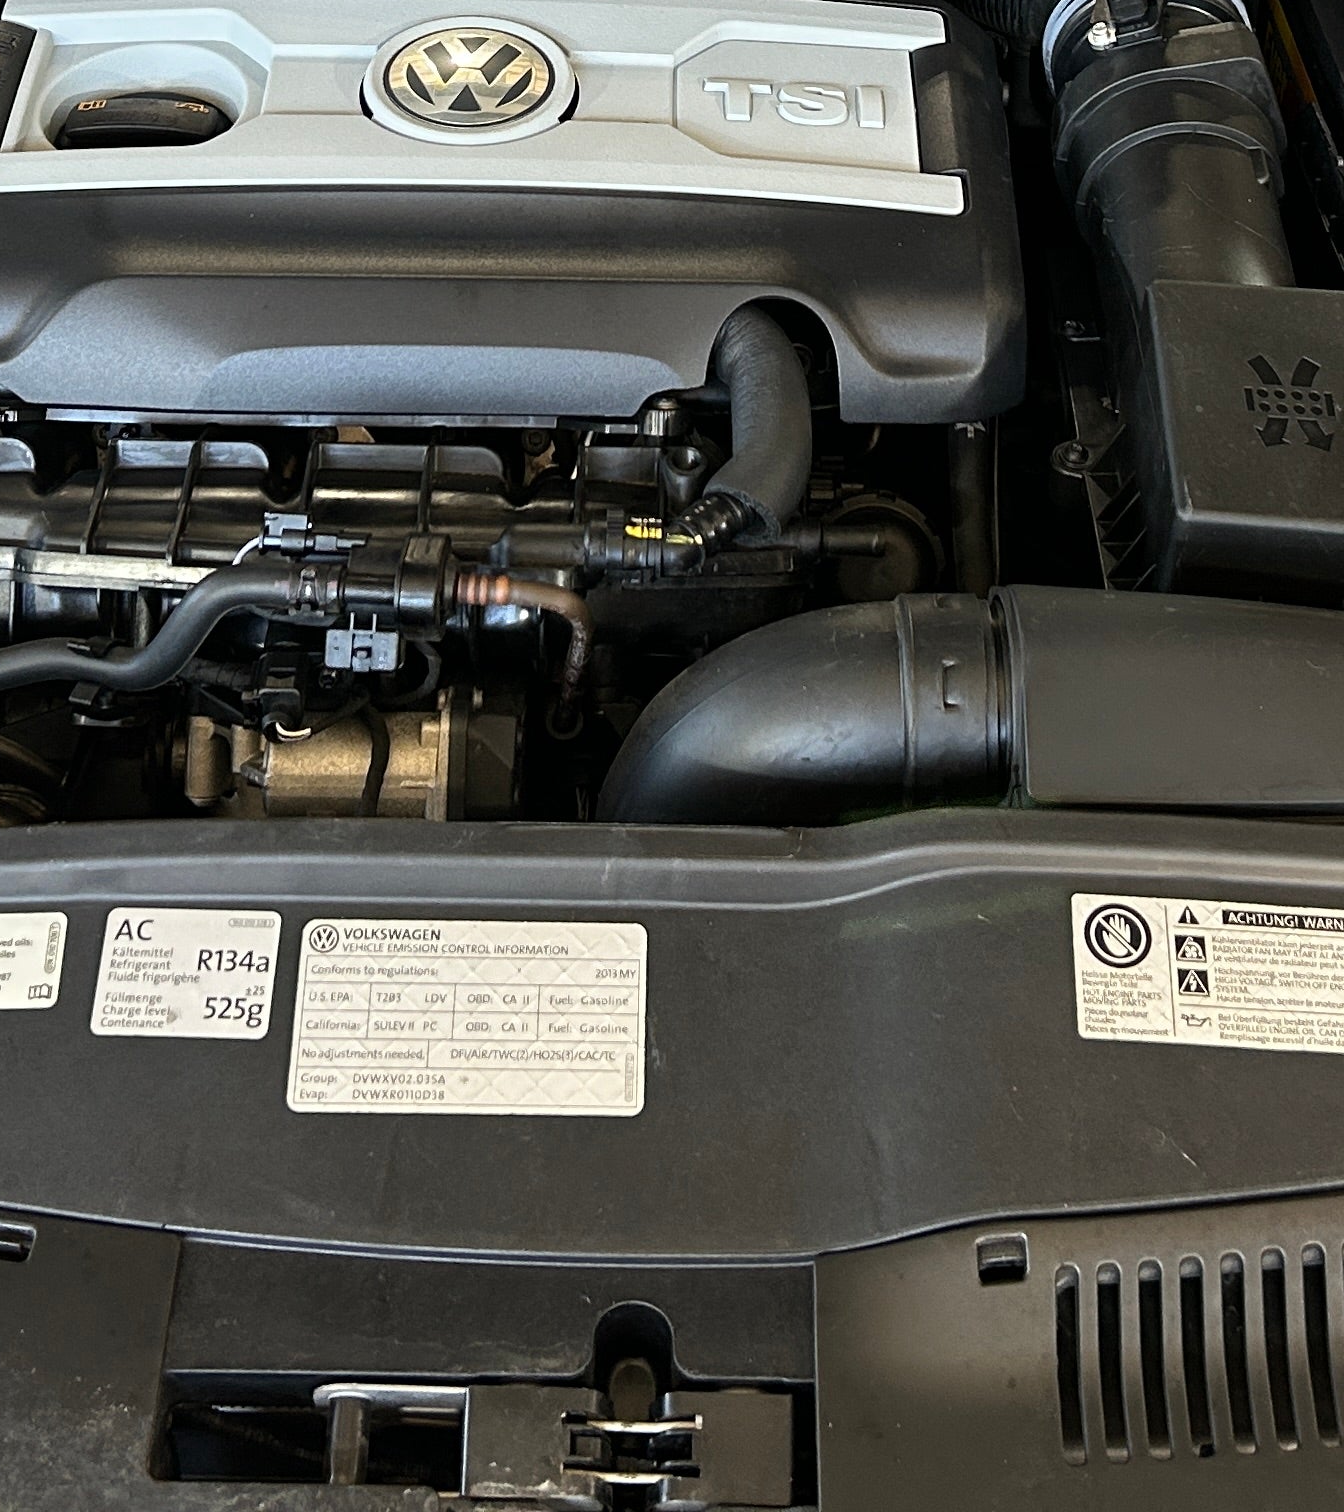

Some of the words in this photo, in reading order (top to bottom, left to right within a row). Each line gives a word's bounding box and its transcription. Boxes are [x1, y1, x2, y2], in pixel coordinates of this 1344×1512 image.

[384, 26, 555, 127] VW
[703, 76, 886, 129] TSI
[1227, 911, 1299, 928] ACHTUNG!
[114, 919, 155, 940] AC
[343, 927, 442, 941] VOLKSWAGEN
[112, 946, 174, 958] Kältemittel
[343, 943, 384, 952] VEHICLE
[387, 943, 438, 953] EMISSION
[441, 944, 491, 954] CONTROL
[494, 945, 569, 955] INFORMATION
[1212, 945, 1253, 954] RADIATOR
[110, 959, 172, 972] Refrigerant
[197, 949, 270, 973] R134a
[311, 964, 361, 975] Conforms
[364, 965, 375, 975] to
[377, 965, 438, 978] regulations:
[595, 968, 618, 978] 2013
[619, 969, 637, 978] MY
[108, 972, 140, 982] Fluide
[142, 972, 201, 986] frigorigène
[1278, 979, 1311, 988] SWITCH
[246, 986, 266, 996] ±25
[105, 991, 163, 1004] Füllmenge
[376, 992, 402, 1003] T2B3
[424, 993, 448, 1003] LDV
[502, 994, 517, 1004] CA
[522, 994, 530, 1004] II
[580, 995, 629, 1005] Gasoline
[102, 1005, 142, 1018] Charge
[145, 1005, 171, 1016] level
[203, 996, 265, 1028] 525g
[100, 1018, 165, 1029] Contenance
[306, 1019, 361, 1030] California:
[374, 1020, 406, 1031] SULEV
[423, 1021, 438, 1031] PC
[501, 1022, 516, 1032] CA
[521, 1022, 529, 1032] II
[579, 1023, 629, 1034] Gasoline
[301, 1048, 318, 1058] No
[318, 1048, 383, 1061] adjustments
[301, 1073, 338, 1086] Group:
[299, 1090, 328, 1101] Evap:
